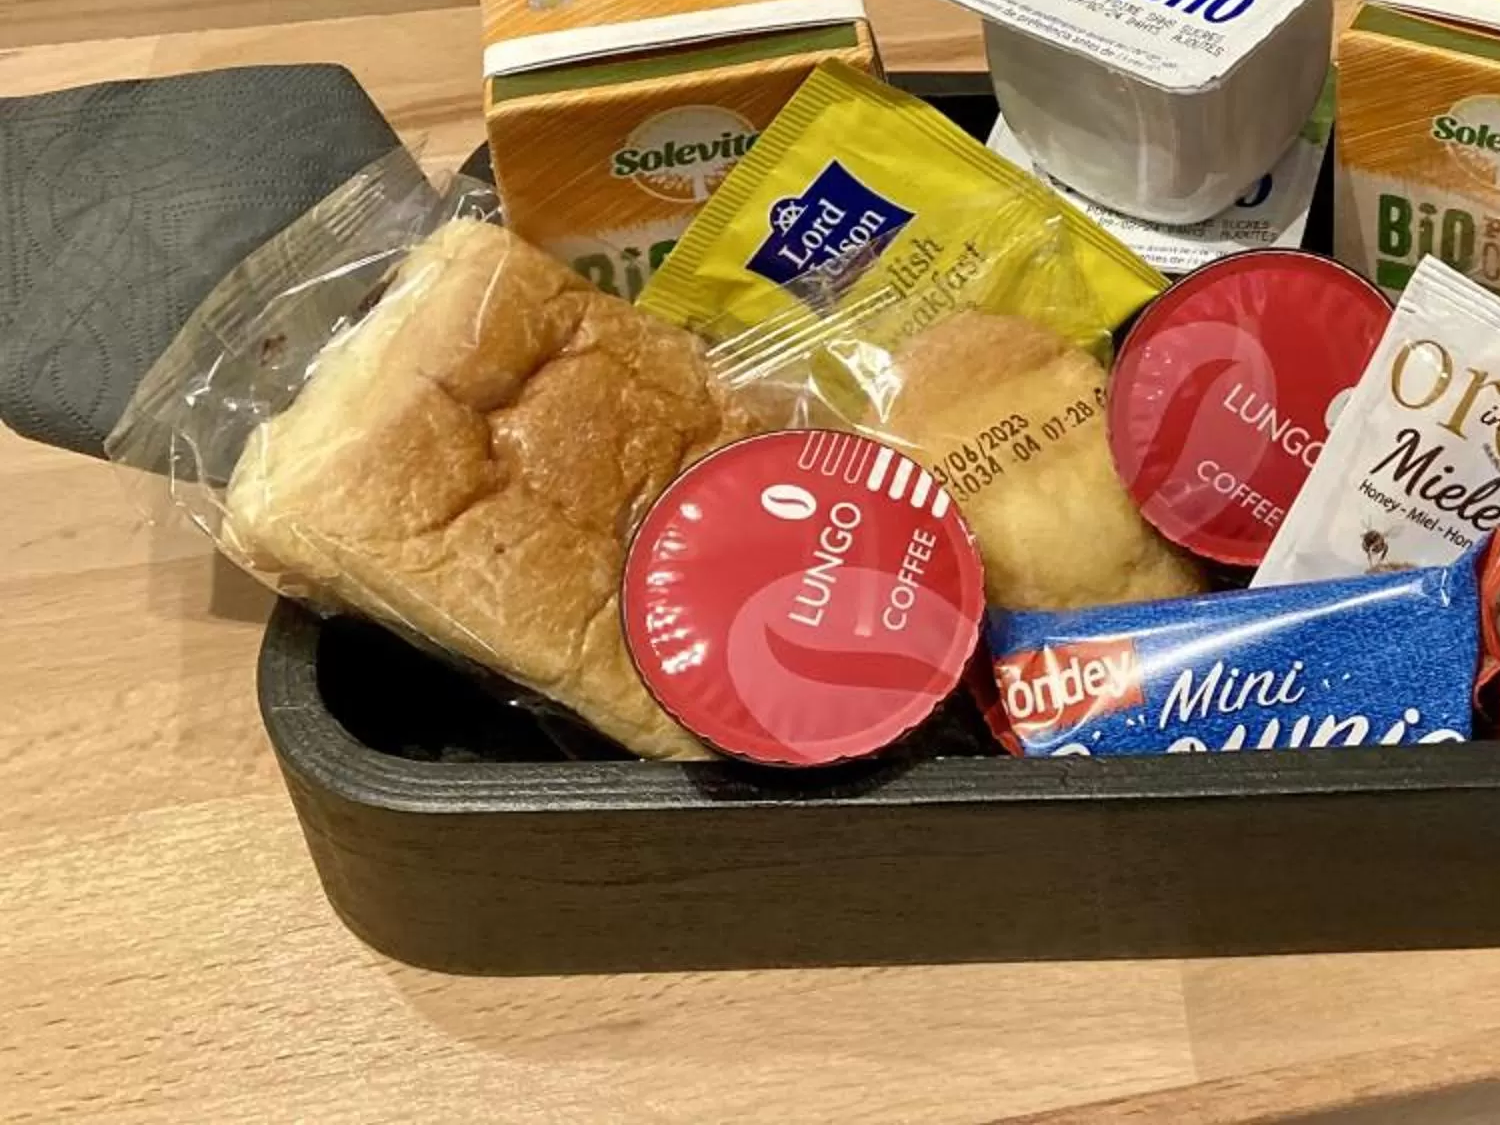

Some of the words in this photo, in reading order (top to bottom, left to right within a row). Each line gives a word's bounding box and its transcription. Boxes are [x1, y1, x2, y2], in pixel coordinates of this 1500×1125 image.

[778, 198, 846, 269] Lord
[1223, 383, 1325, 468] LUNGO
[1197, 460, 1285, 527] COFFEE
[1360, 479, 1401, 514] Honey
[1408, 506, 1438, 532] Miel
[789, 502, 861, 628] LUNGO
[883, 529, 937, 632] COFFEE
[1160, 661, 1307, 729] Mini
